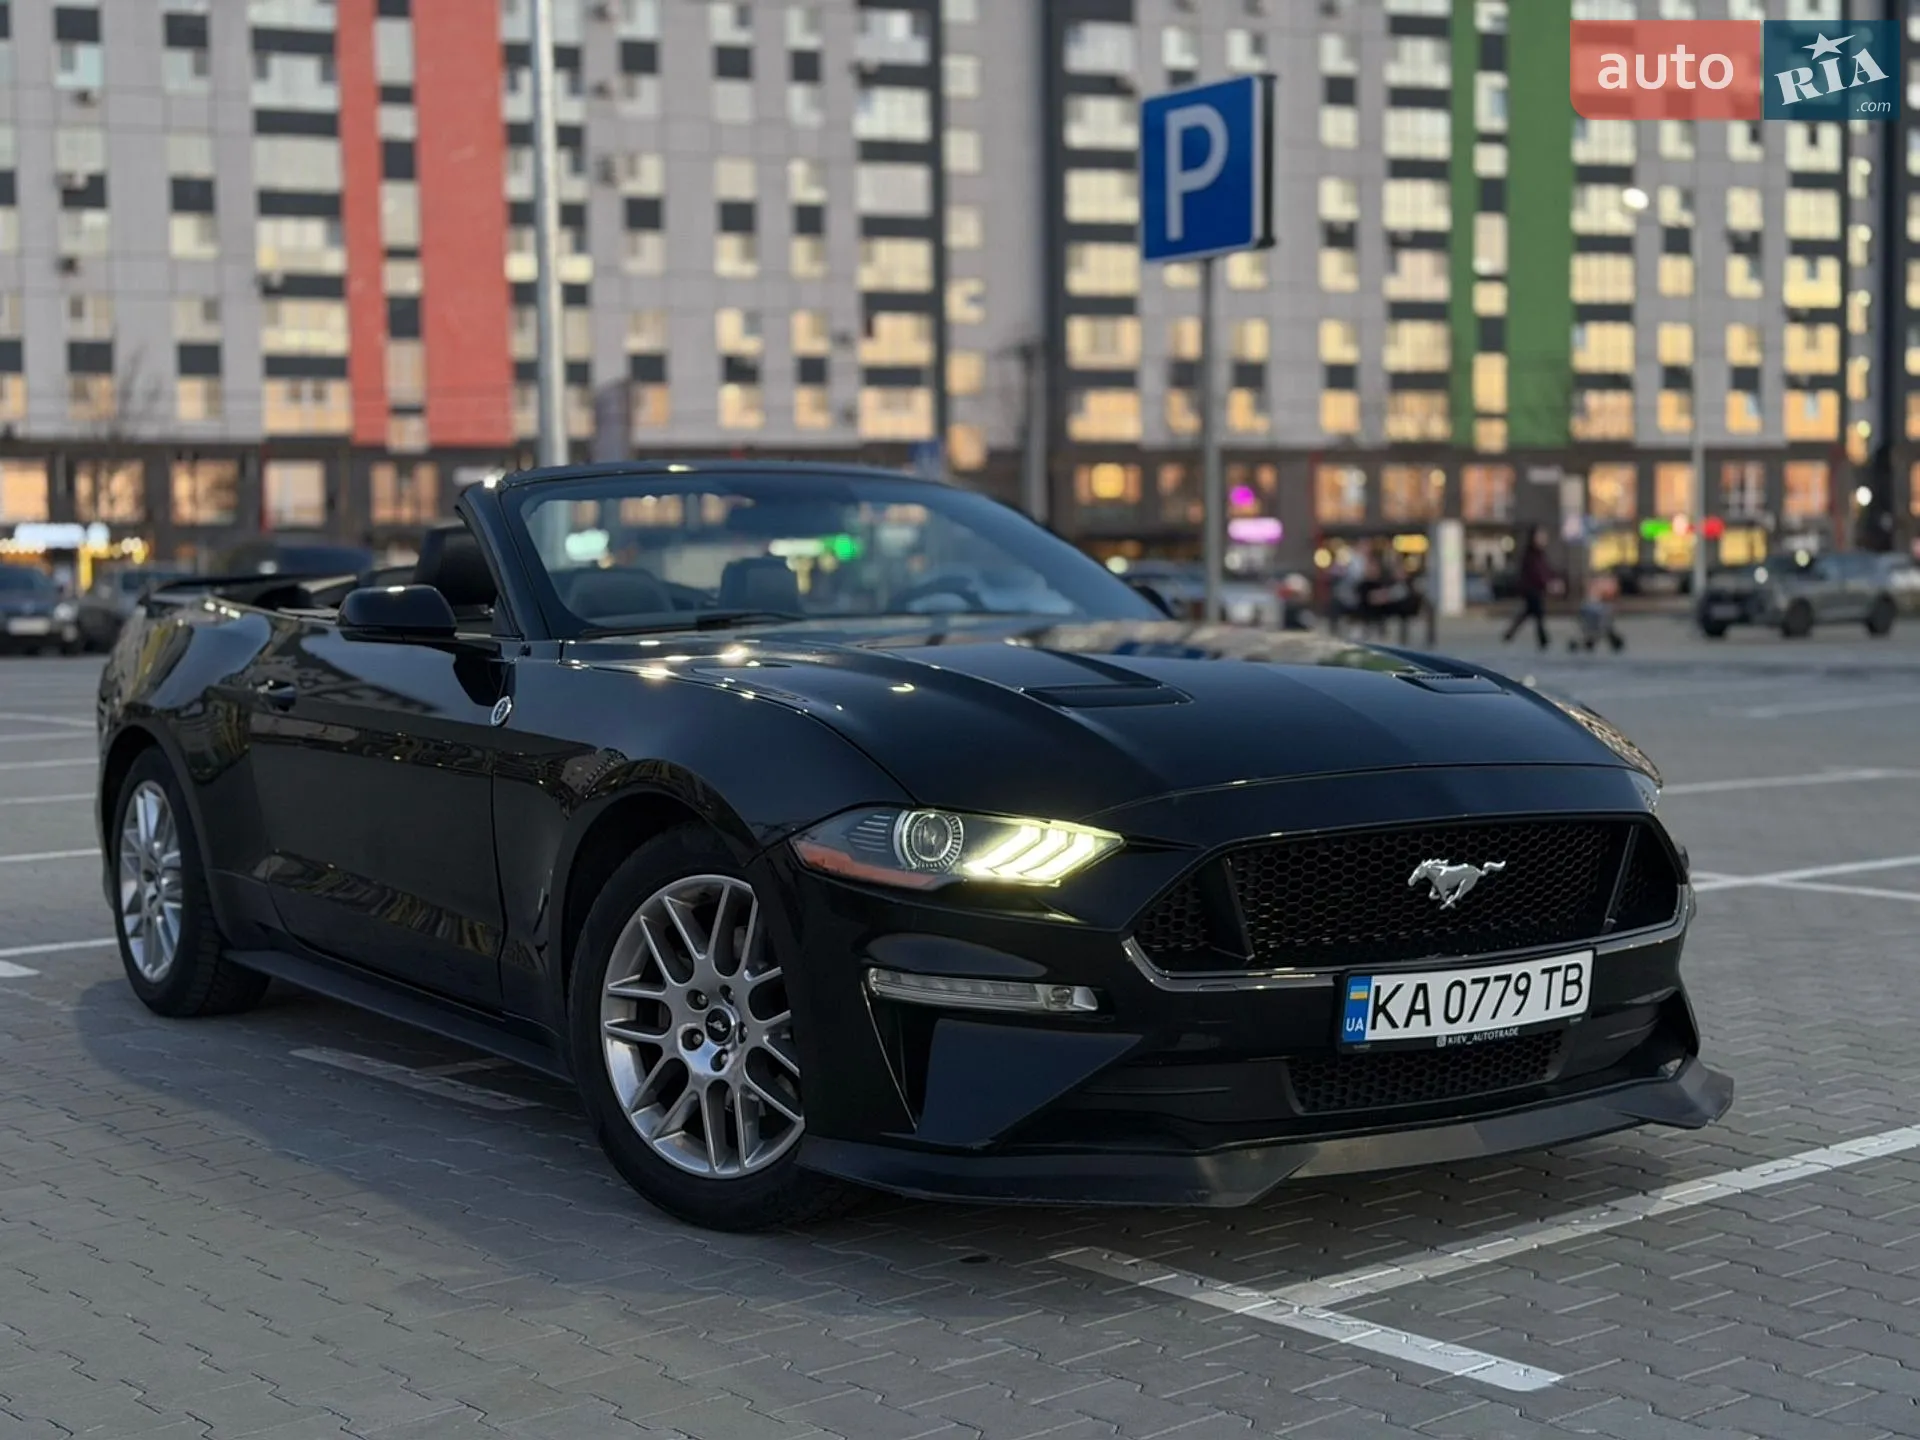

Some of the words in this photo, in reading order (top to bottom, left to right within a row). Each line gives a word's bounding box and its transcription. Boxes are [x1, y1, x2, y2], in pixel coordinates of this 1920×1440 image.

[1165, 103, 1229, 242] P
[1345, 1017, 1364, 1032] UA
[1370, 982, 1432, 1031] KA
[1443, 971, 1532, 1025] 0779
[1540, 962, 1583, 1011] TB
